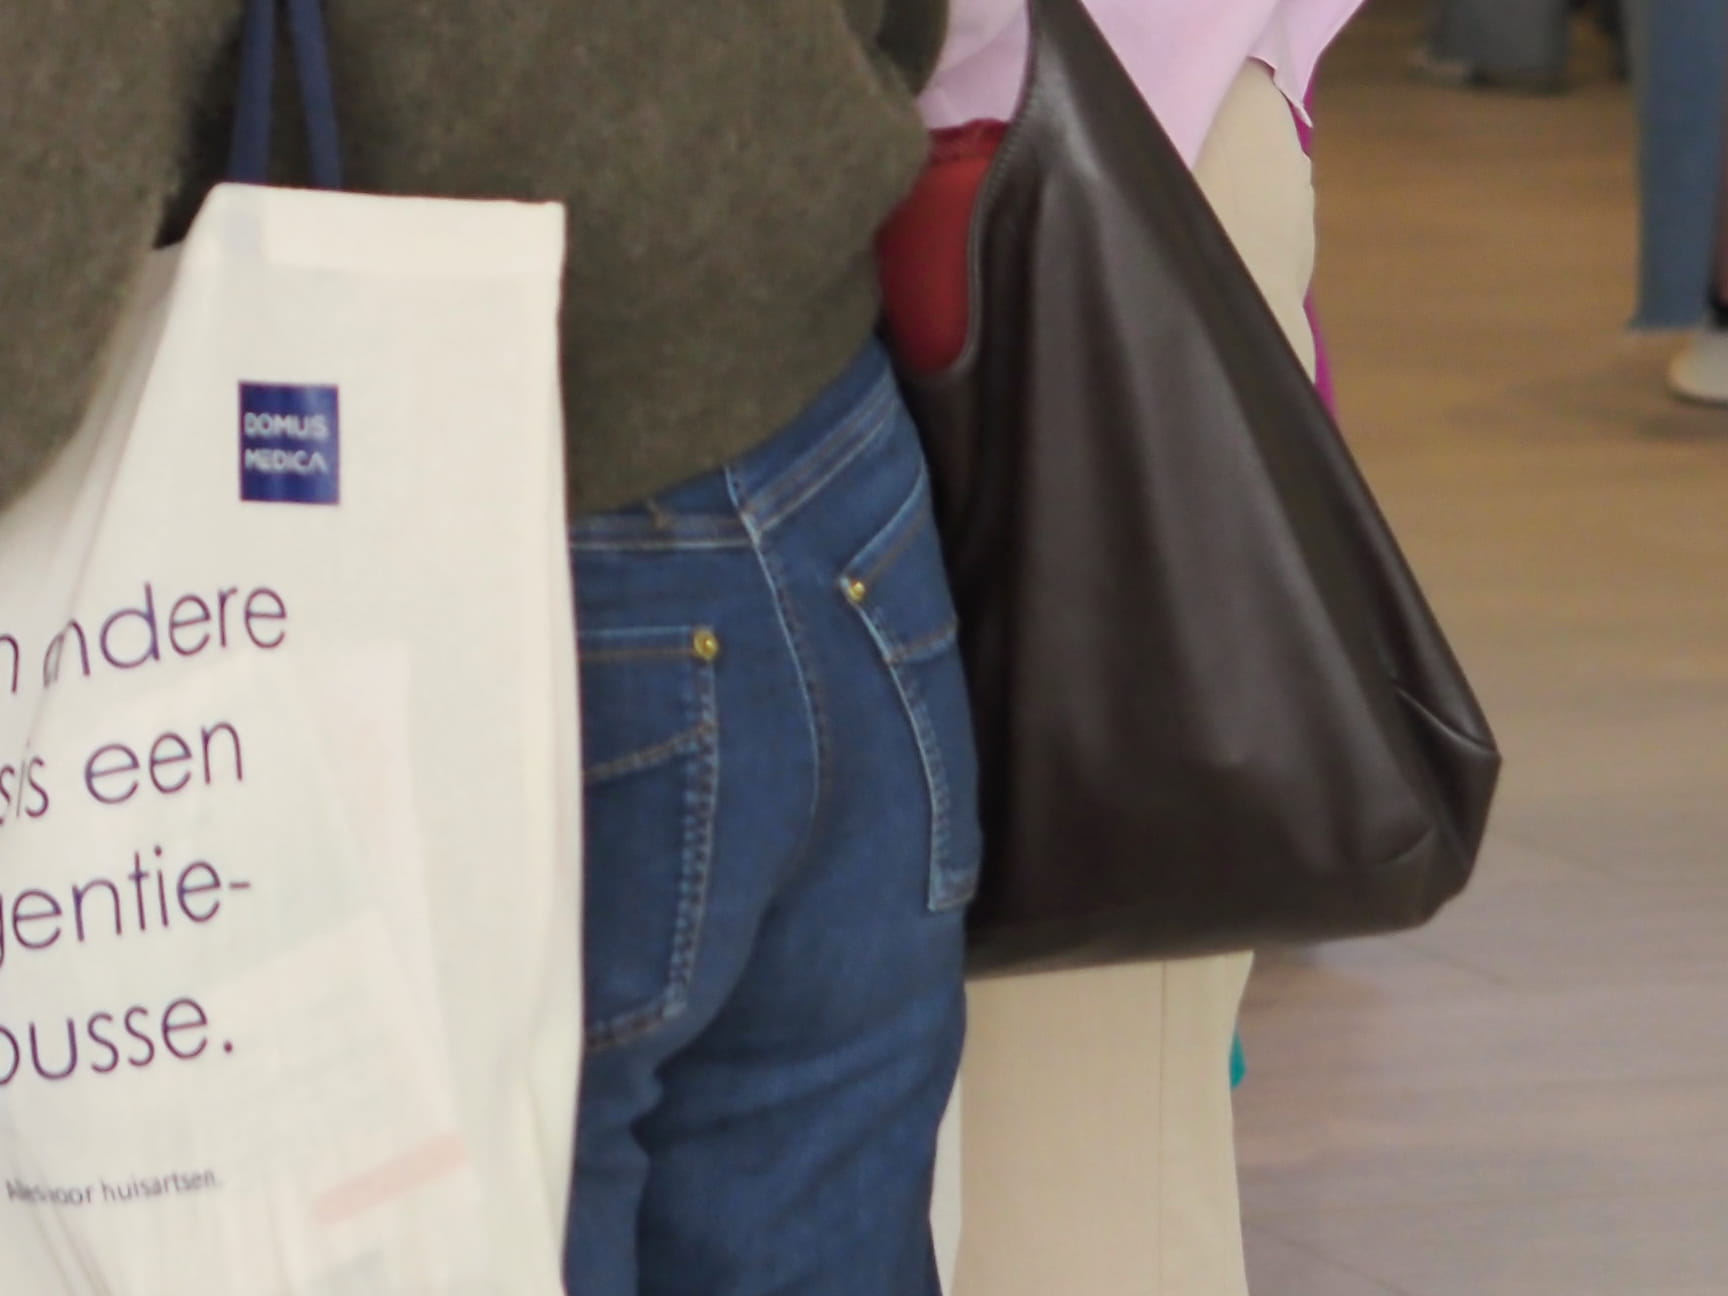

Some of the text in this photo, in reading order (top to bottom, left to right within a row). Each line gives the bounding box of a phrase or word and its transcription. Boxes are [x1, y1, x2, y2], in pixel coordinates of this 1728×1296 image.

[244, 410, 329, 442] DOMUS
[244, 446, 331, 476] MEDICA
[84, 720, 243, 805] een
